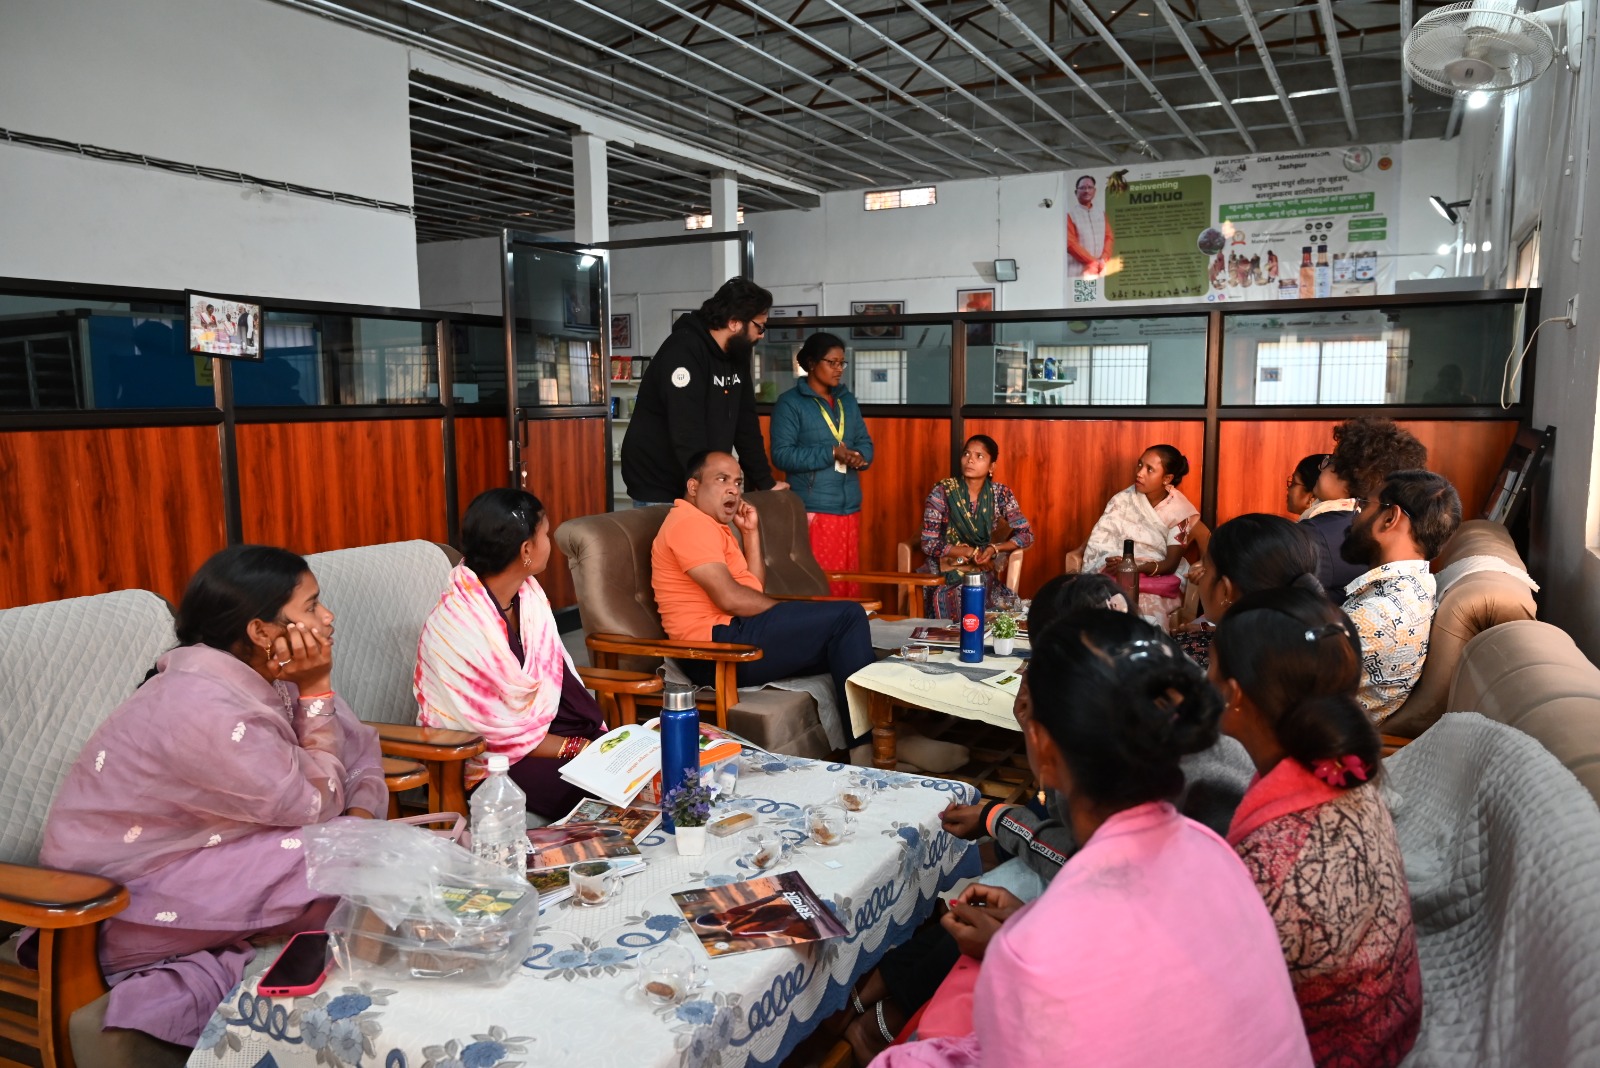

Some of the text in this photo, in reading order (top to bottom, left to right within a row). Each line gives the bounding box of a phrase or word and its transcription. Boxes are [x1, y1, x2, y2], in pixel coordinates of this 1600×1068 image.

[1278, 162, 1307, 171] Jashpur
[1129, 181, 1179, 191] Reinventing
[1129, 191, 1183, 205] Mahua
